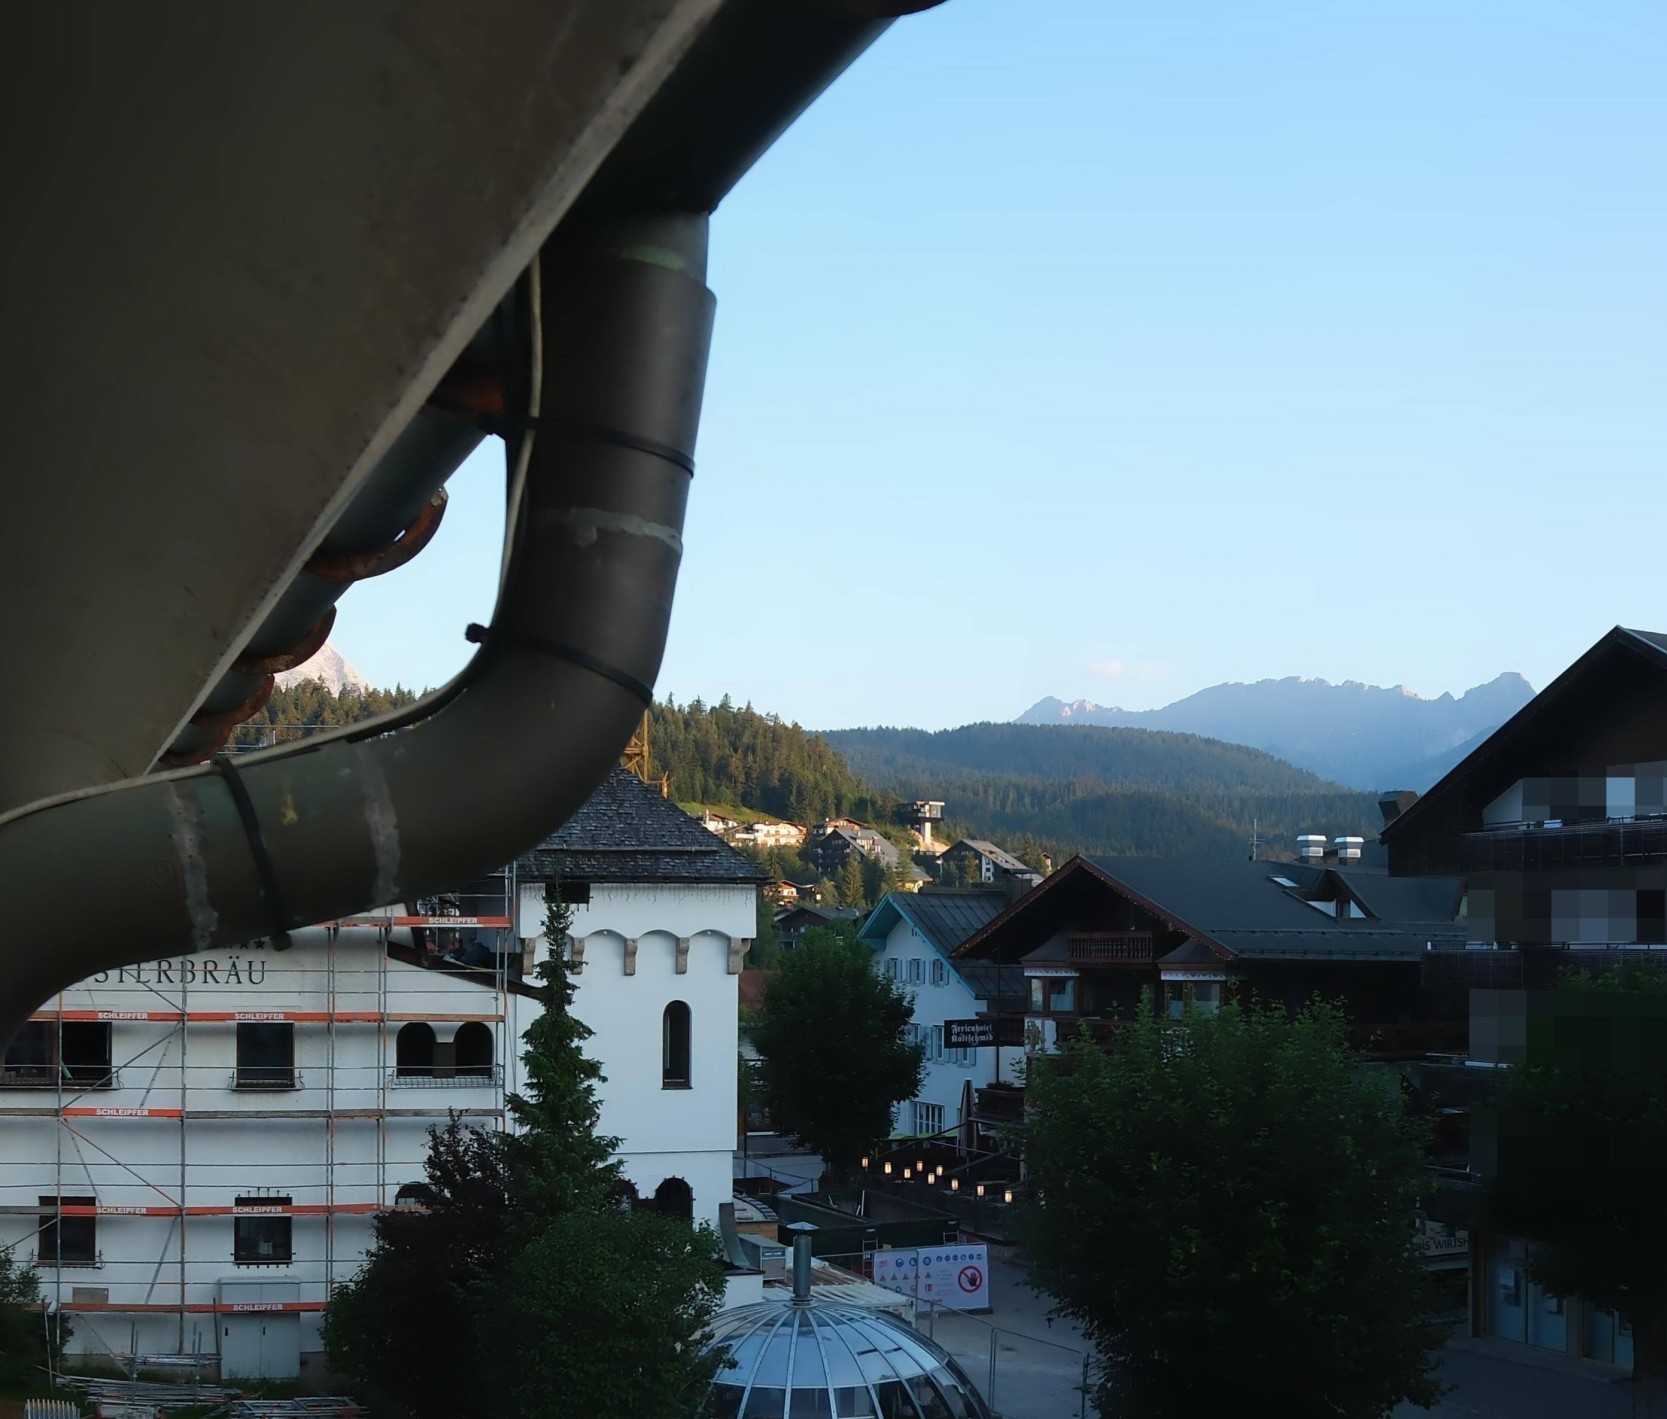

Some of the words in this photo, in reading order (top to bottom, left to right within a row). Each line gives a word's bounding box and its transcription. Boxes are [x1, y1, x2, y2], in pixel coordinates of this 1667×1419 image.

[97, 1011, 149, 1020] SCHLEIPFER
[234, 1012, 285, 1020] SCHLEIPFER
[96, 1108, 149, 1117] SCHLEIPFER
[96, 1206, 148, 1215] SCHLEIPFER
[232, 1205, 283, 1214] SCHLEIPFER
[232, 1303, 284, 1312] SCHLEIPFER
